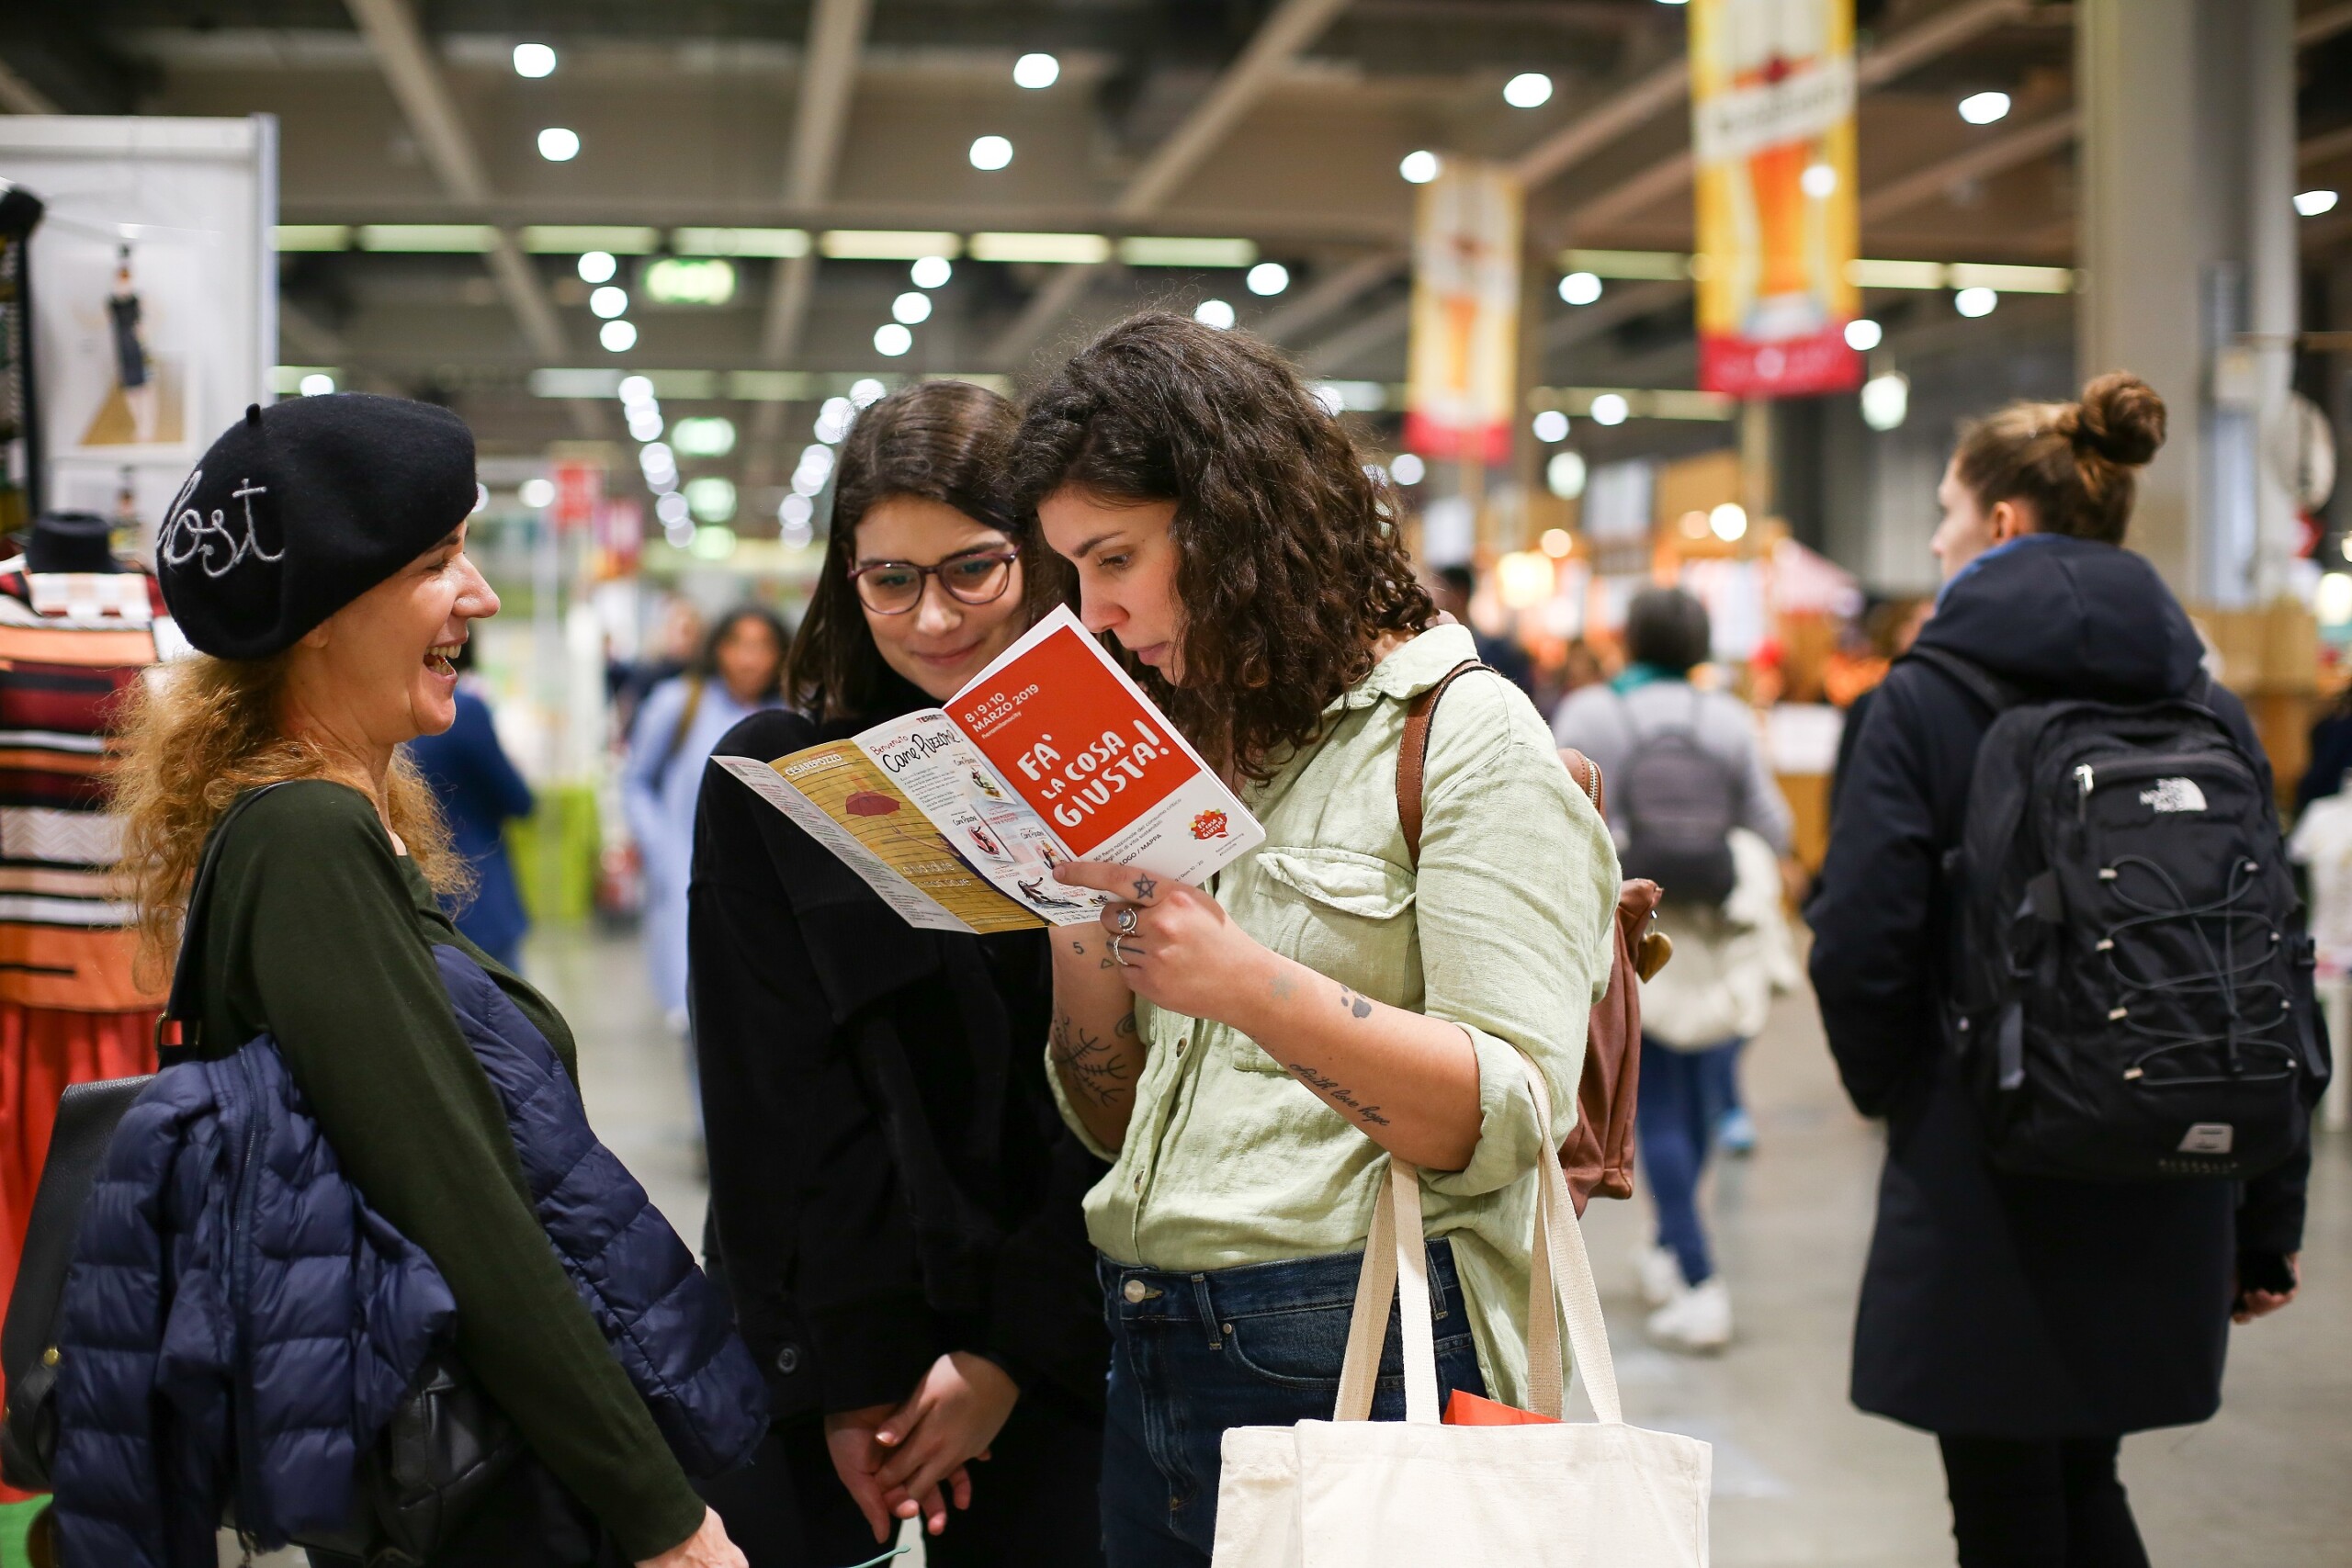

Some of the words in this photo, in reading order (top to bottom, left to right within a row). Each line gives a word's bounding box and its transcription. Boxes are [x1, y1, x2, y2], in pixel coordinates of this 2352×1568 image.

[972, 702, 1013, 732] MARZO
[1012, 683, 1039, 705] 2019
[869, 735, 909, 755] Benvenuto
[883, 748, 921, 773] Cane
[1041, 778, 1066, 799] LA
[1065, 731, 1125, 781] COSA
[1054, 719, 1170, 827] GIUSTA!
[1119, 852, 1137, 866] LOGO
[1140, 833, 1162, 852] MAPPA
[1073, 942, 1084, 954] 5
[1330, 1089, 1360, 1108] love
[1357, 1106, 1391, 1126] hope
